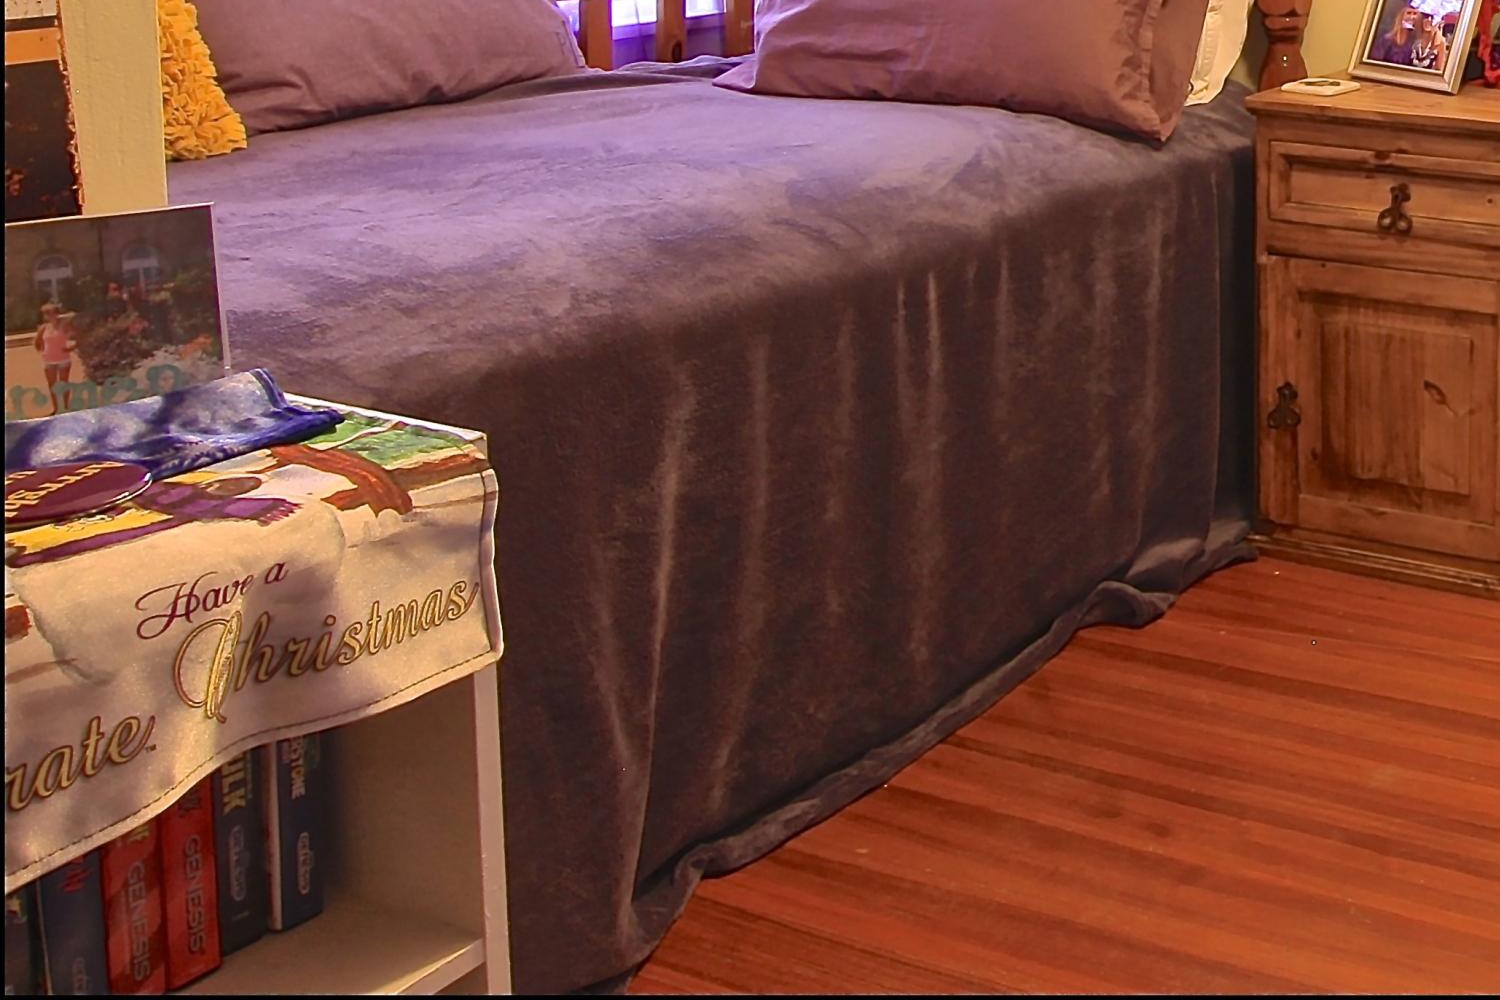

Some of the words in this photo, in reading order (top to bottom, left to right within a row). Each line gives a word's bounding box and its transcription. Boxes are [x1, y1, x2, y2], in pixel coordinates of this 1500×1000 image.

[136, 570, 254, 640] Have
[263, 561, 288, 585] a
[173, 580, 479, 724] Christmas
[127, 861, 152, 982] GENESIS
[183, 833, 206, 953] GENESIS
